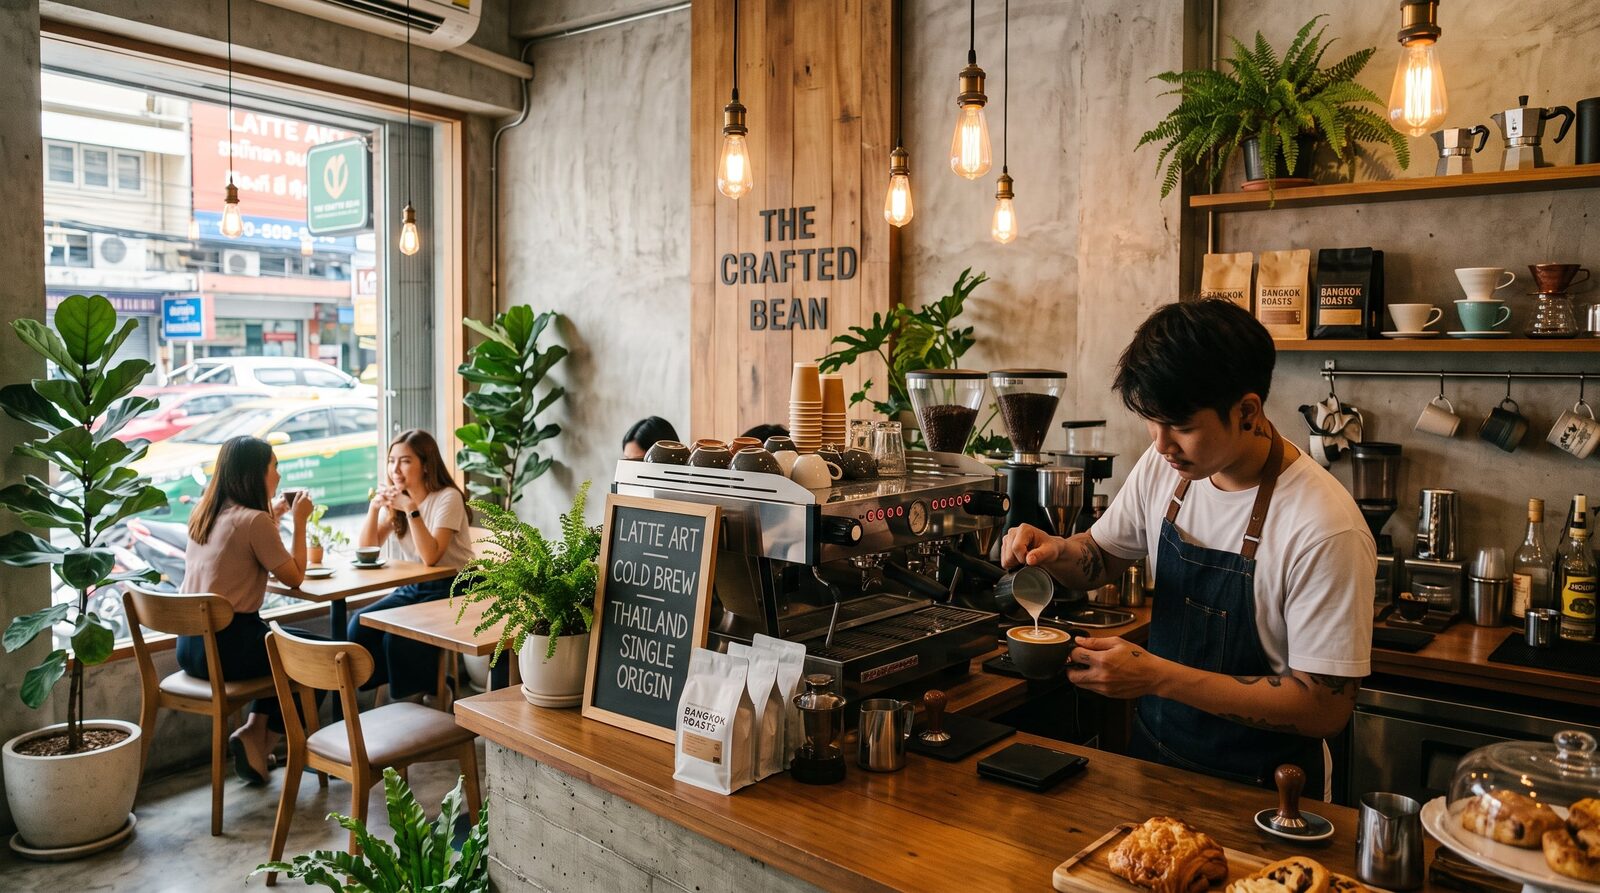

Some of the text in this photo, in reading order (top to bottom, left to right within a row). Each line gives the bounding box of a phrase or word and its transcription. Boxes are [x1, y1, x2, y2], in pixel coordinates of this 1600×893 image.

[227, 109, 299, 141] LATTE
[759, 206, 816, 242] THE
[720, 246, 858, 286] CRAFTED
[1207, 291, 1244, 299] BANGKOK
[1261, 288, 1301, 297] BANGKOK
[1261, 297, 1292, 305] ROASTS
[1320, 287, 1362, 296] BANGKOK
[1320, 296, 1353, 305] ROASTS
[750, 297, 828, 331] BEAN
[619, 518, 700, 553] LATTE ART
[613, 559, 696, 596] COLD BREW
[611, 600, 688, 639] THAILAND
[619, 634, 676, 669] SINGLE
[616, 664, 673, 701] ORIGIN
[683, 716, 716, 733] ROASTS
[684, 706, 726, 726] BANGKOK
